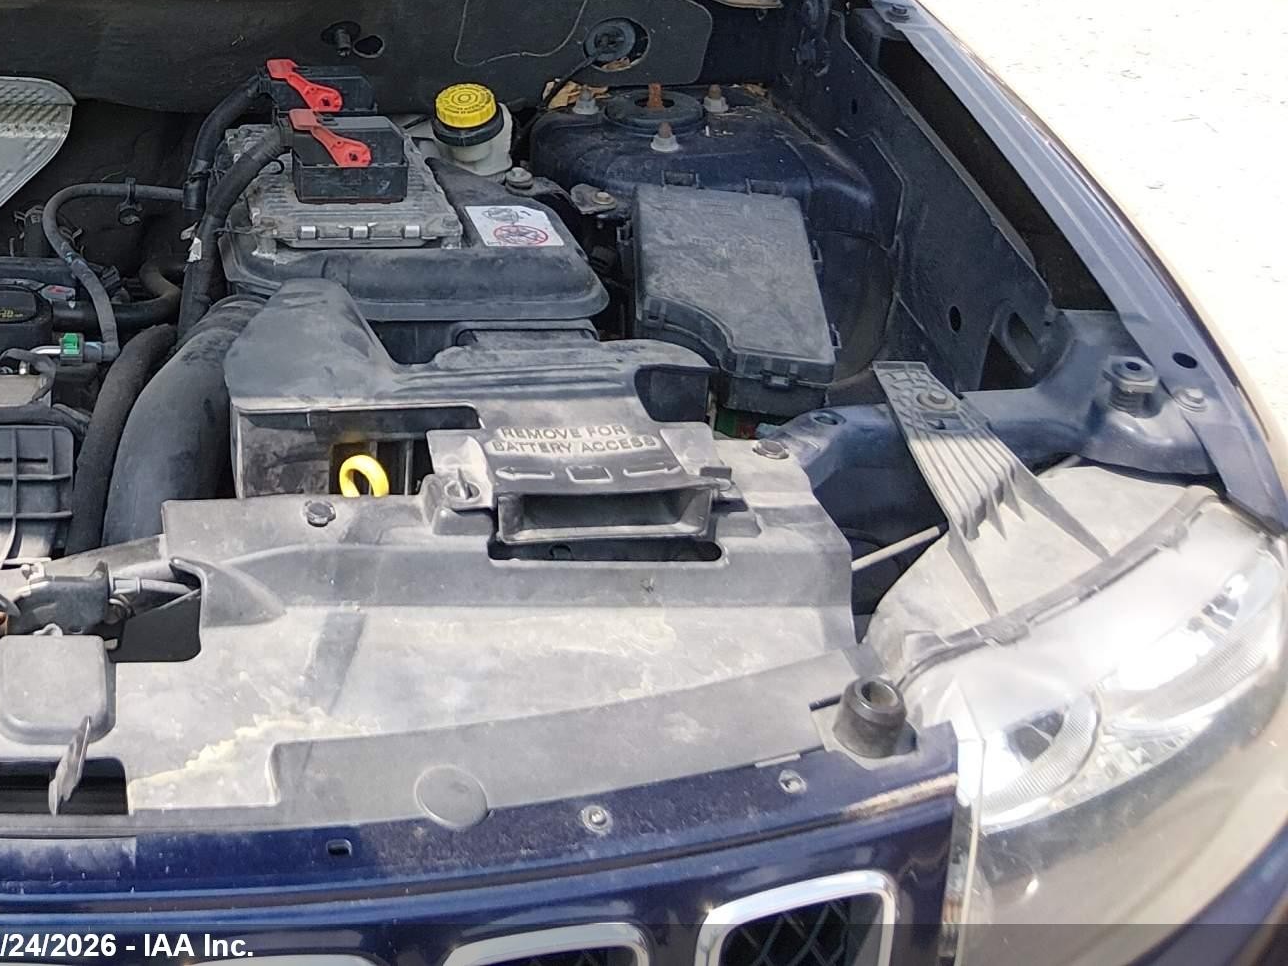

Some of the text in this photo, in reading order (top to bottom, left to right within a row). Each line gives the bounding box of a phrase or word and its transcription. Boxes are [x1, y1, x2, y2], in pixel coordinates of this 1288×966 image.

[498, 424, 627, 440] REMOVE FOR
[493, 434, 657, 454] BATTERY ACCESS
